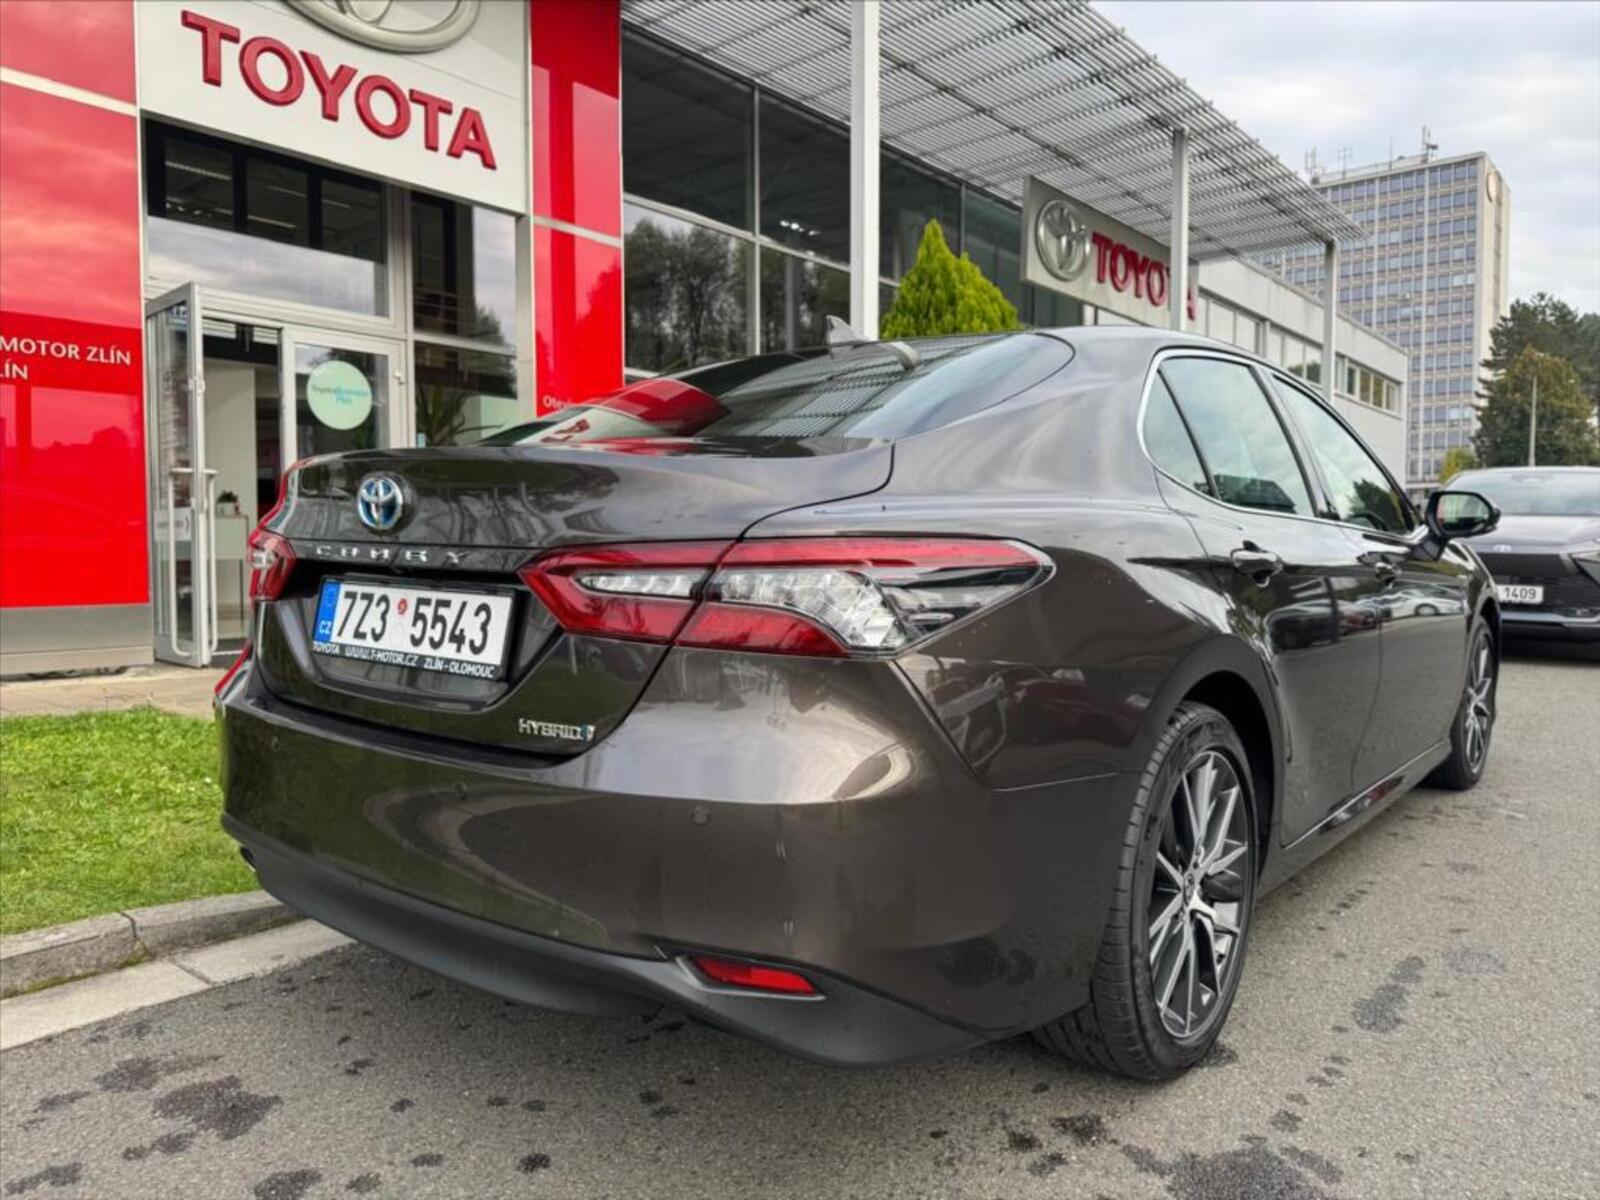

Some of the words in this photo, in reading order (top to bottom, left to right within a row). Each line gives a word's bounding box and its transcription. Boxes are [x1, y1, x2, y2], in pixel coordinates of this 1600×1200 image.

[181, 10, 497, 171] TOYOTA
[1092, 231, 1195, 321] TOYO
[86, 345, 131, 366] ZLÍN
[316, 545, 470, 564] CAMRY
[1504, 587, 1537, 600] 1409
[319, 619, 332, 634] CZ
[337, 591, 390, 642] 7Z3
[410, 597, 492, 655] 5543
[312, 640, 340, 655] TOYOTA
[518, 718, 583, 740] HYBRID
